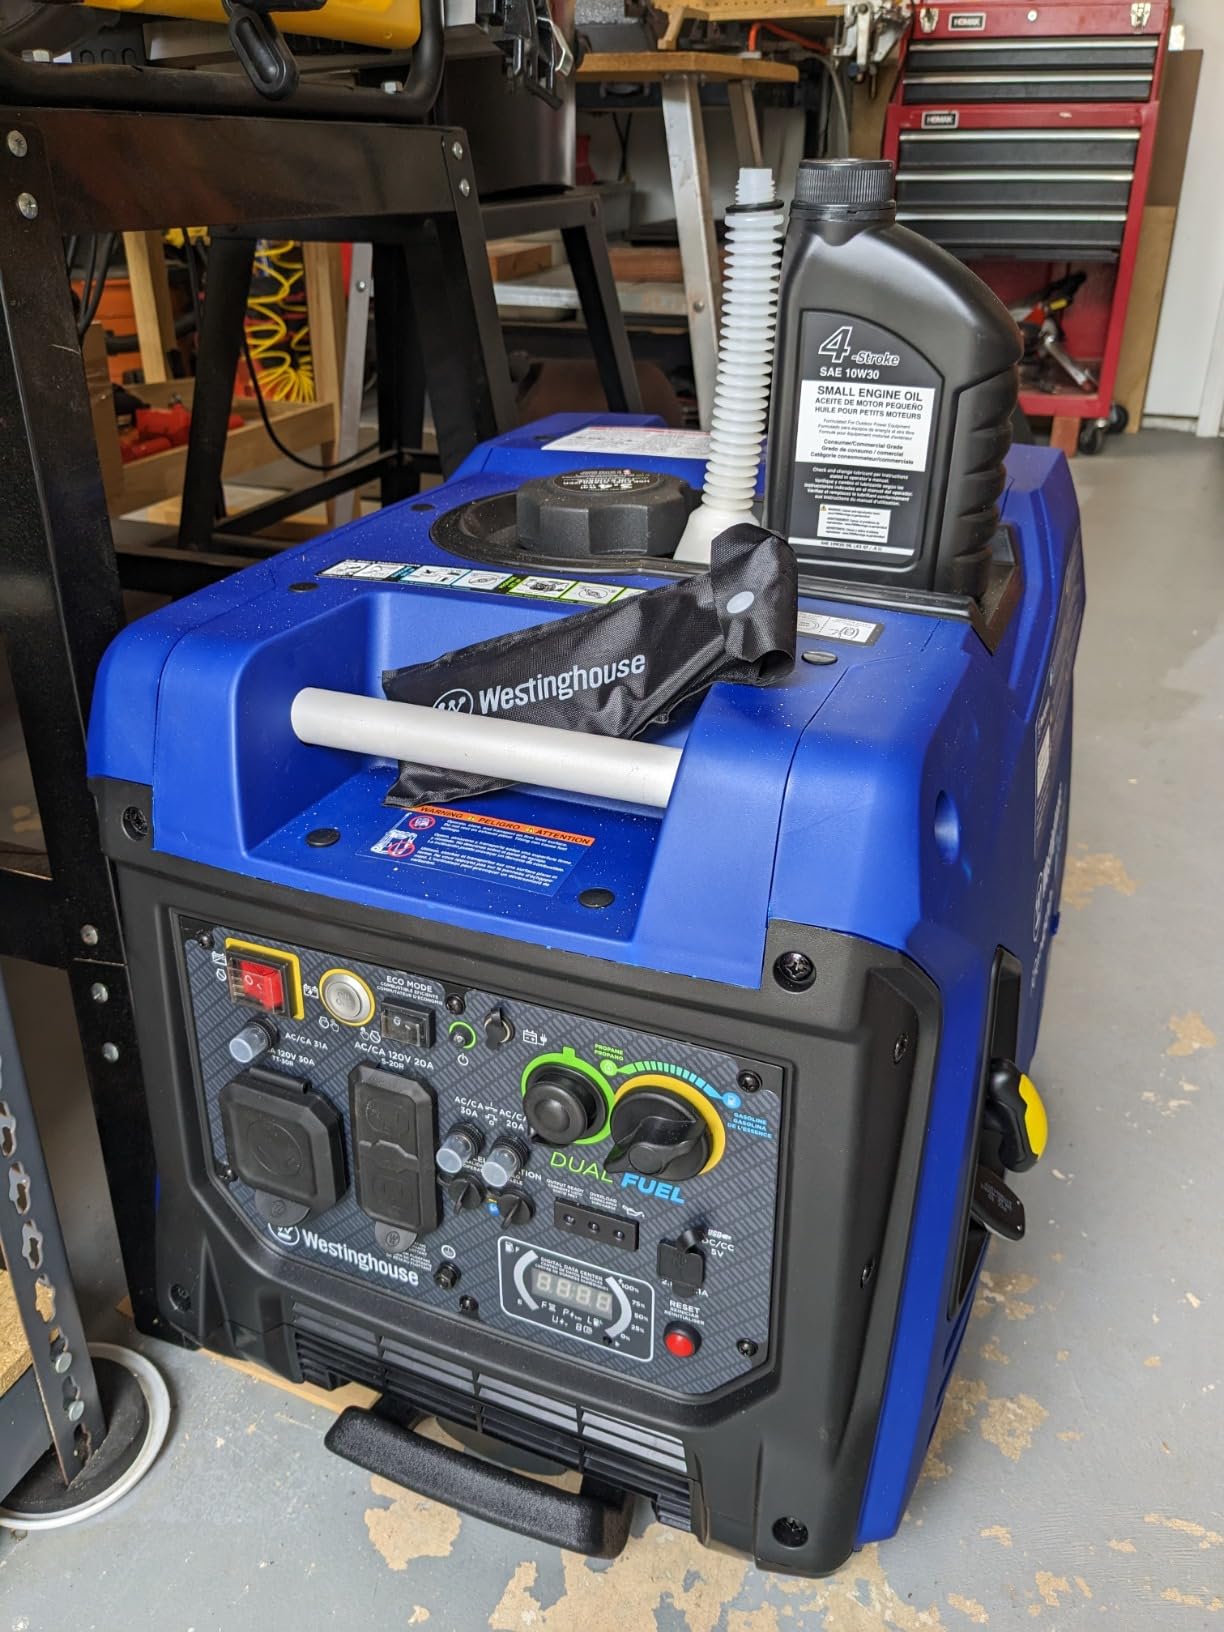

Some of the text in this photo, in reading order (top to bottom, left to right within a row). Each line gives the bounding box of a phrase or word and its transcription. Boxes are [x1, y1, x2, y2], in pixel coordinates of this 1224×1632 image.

[820, 366, 880, 380] SAE 10W30
[817, 385, 924, 402] SMALL ENGINE OIL
[815, 398, 924, 411] ACEITE DE MOTOR PEQUEÑO
[815, 406, 922, 420] HUILE POUR PETITS MOTEURS
[824, 438, 886, 450] Consumer/Commercial
[479, 654, 646, 715] Westinghouse
[420, 806, 591, 845] WARNING PELIGRO ATTENTION
[386, 975, 433, 993] ECO MODE
[284, 1032, 328, 1050] AC/CA 31A
[277, 1048, 297, 1060] 120V
[298, 1055, 316, 1066] 30A
[354, 1041, 434, 1070] AC/CA 120V 20A
[594, 1044, 624, 1056] PROPANE
[594, 1050, 624, 1062] PROPANO
[381, 1058, 405, 1070] 5-20R
[454, 1096, 484, 1111] AC/CA
[460, 1106, 478, 1118] 30A
[734, 1112, 768, 1126] GASOLINE
[506, 1120, 524, 1132] 20A
[727, 1122, 772, 1140] DE L'ESSENCE
[732, 1118, 767, 1132] GASOLINA
[550, 1150, 613, 1184] DUAL
[620, 1172, 686, 1204] FUEL
[302, 1228, 420, 1286] Westinghouse
[711, 1248, 724, 1258] 5V
[540, 1256, 604, 1281] DIGITAL DATA CENTER
[670, 1300, 700, 1313] RESET
